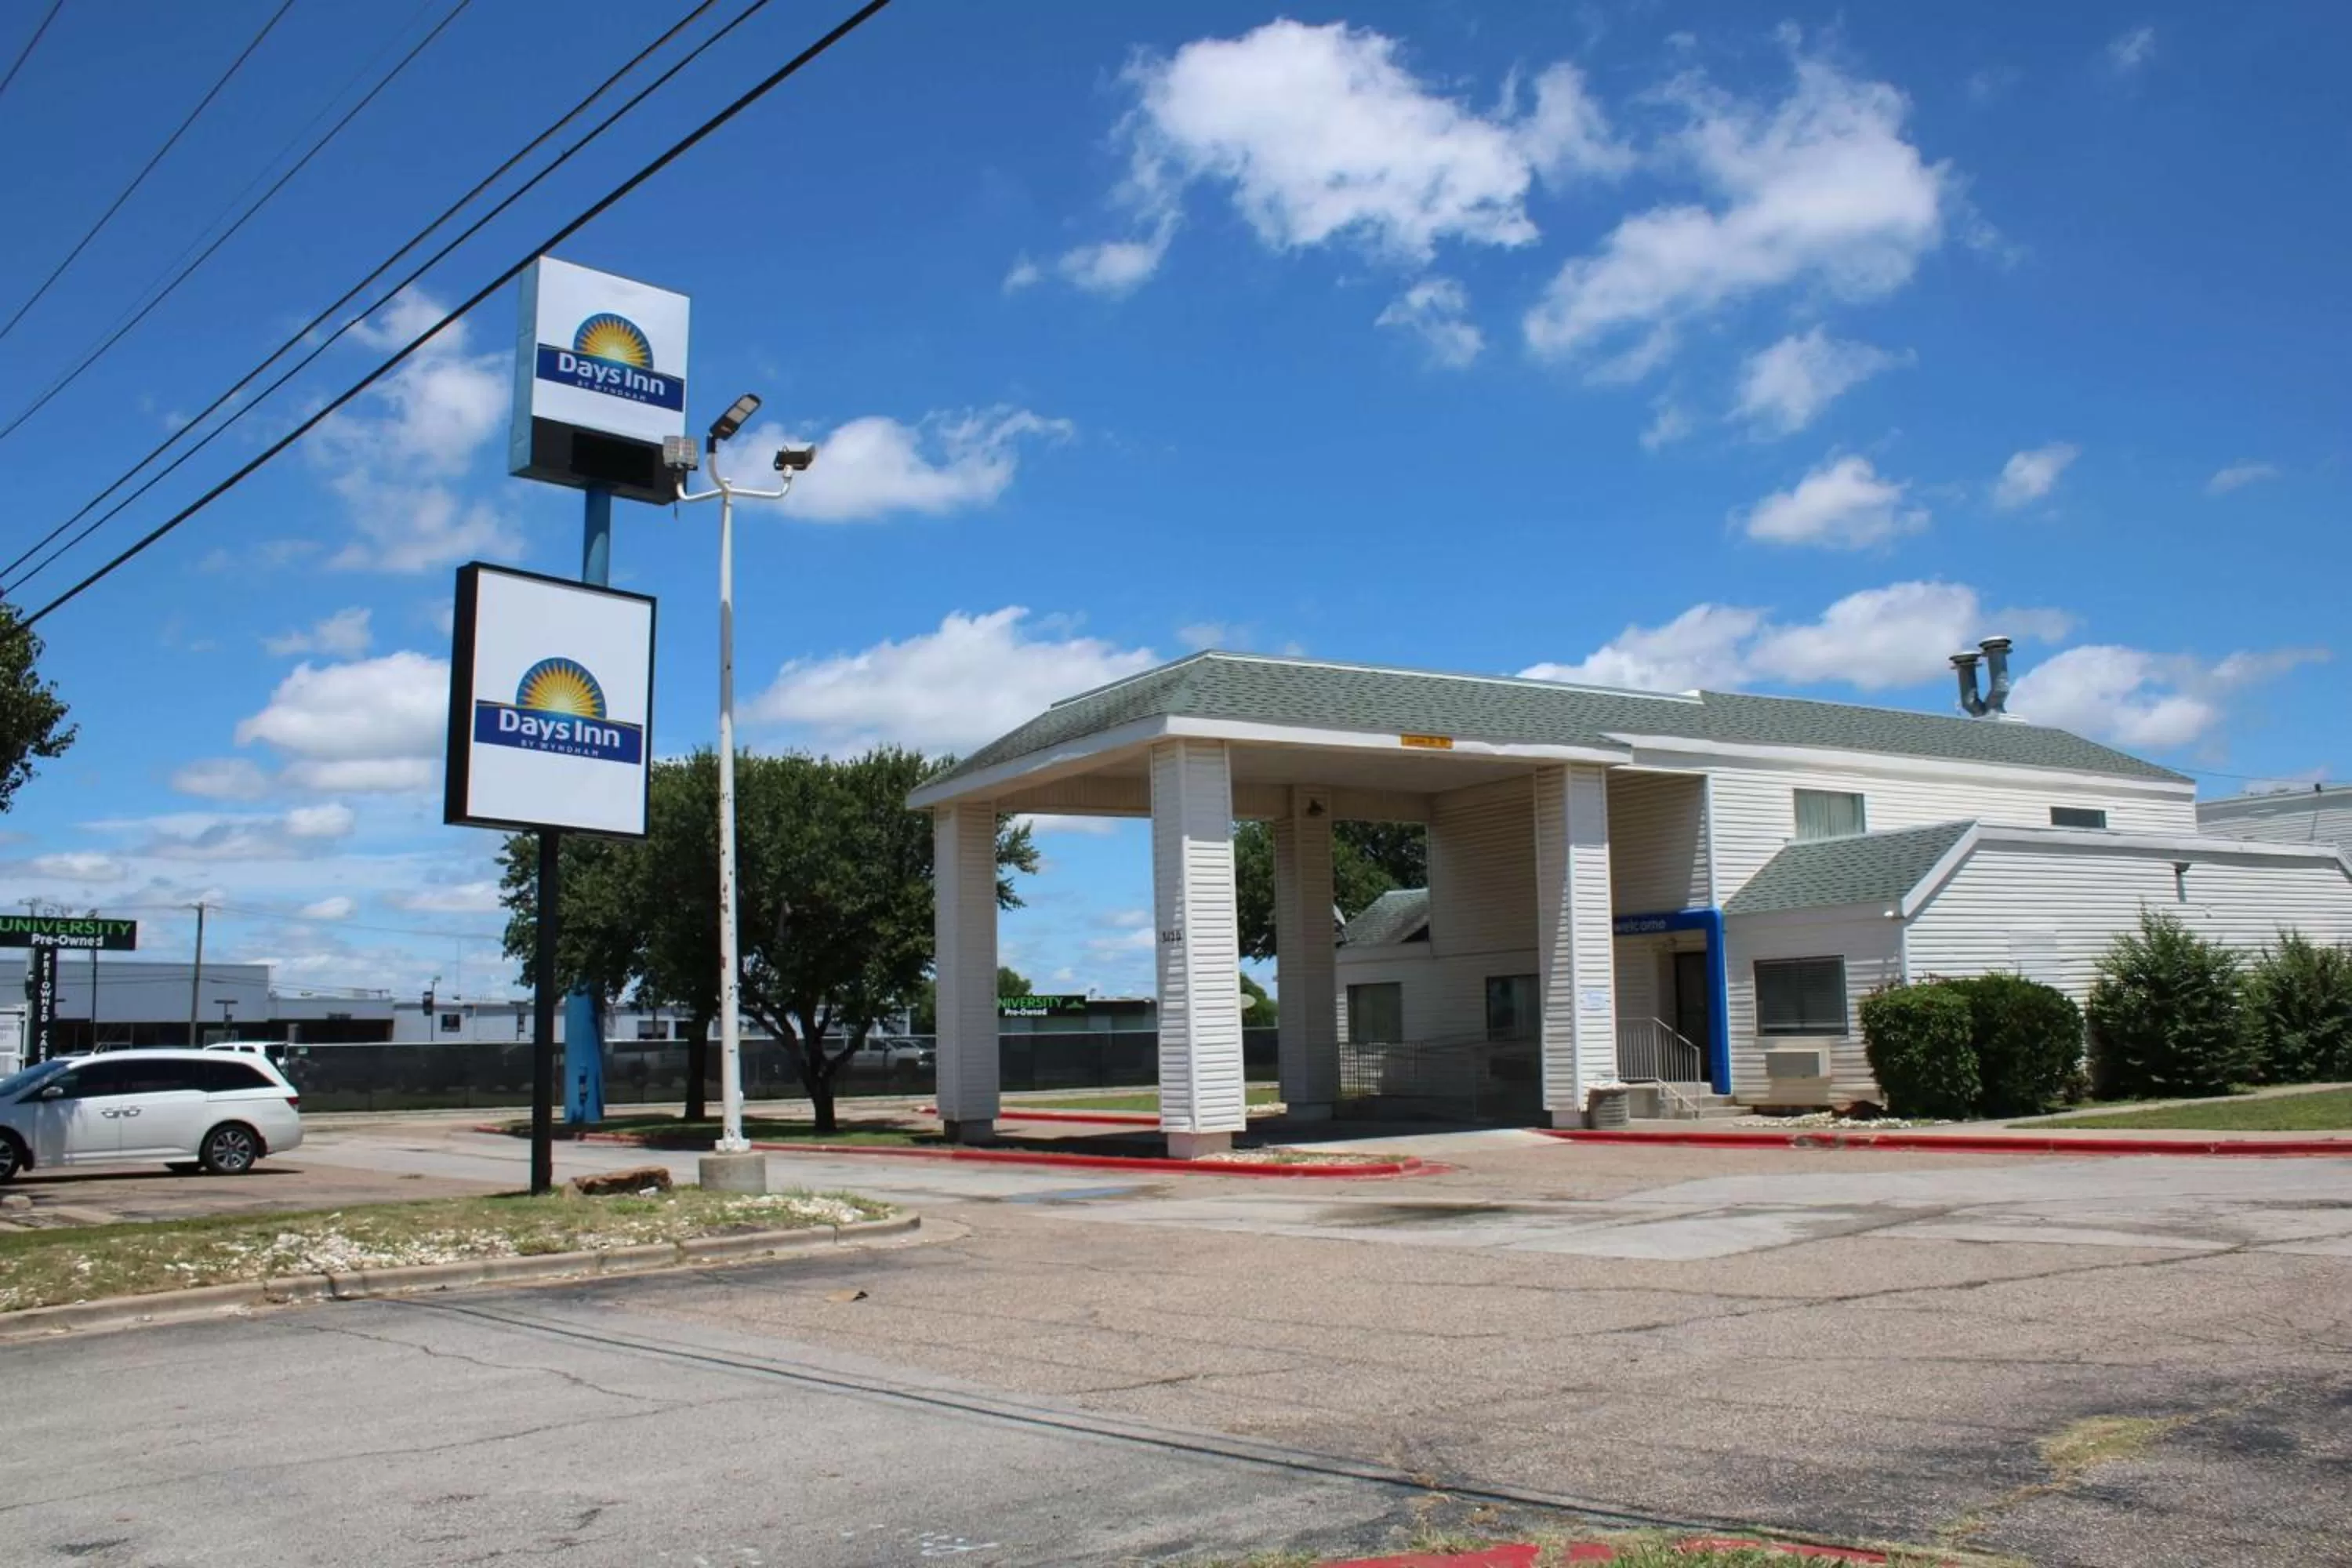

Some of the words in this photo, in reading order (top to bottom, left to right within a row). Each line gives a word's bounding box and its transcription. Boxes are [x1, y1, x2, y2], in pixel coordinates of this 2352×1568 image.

[558, 352, 622, 385] Days
[625, 368, 666, 396] Inn
[594, 383, 647, 401] WYNDHAM
[499, 708, 571, 741] Days
[575, 720, 620, 748] Inn
[539, 742, 600, 757] WYNDHAM
[0, 917, 132, 935] UNIVERSITY
[31, 933, 104, 947] Pre-Owned
[998, 996, 1063, 1008] NIVERSITY
